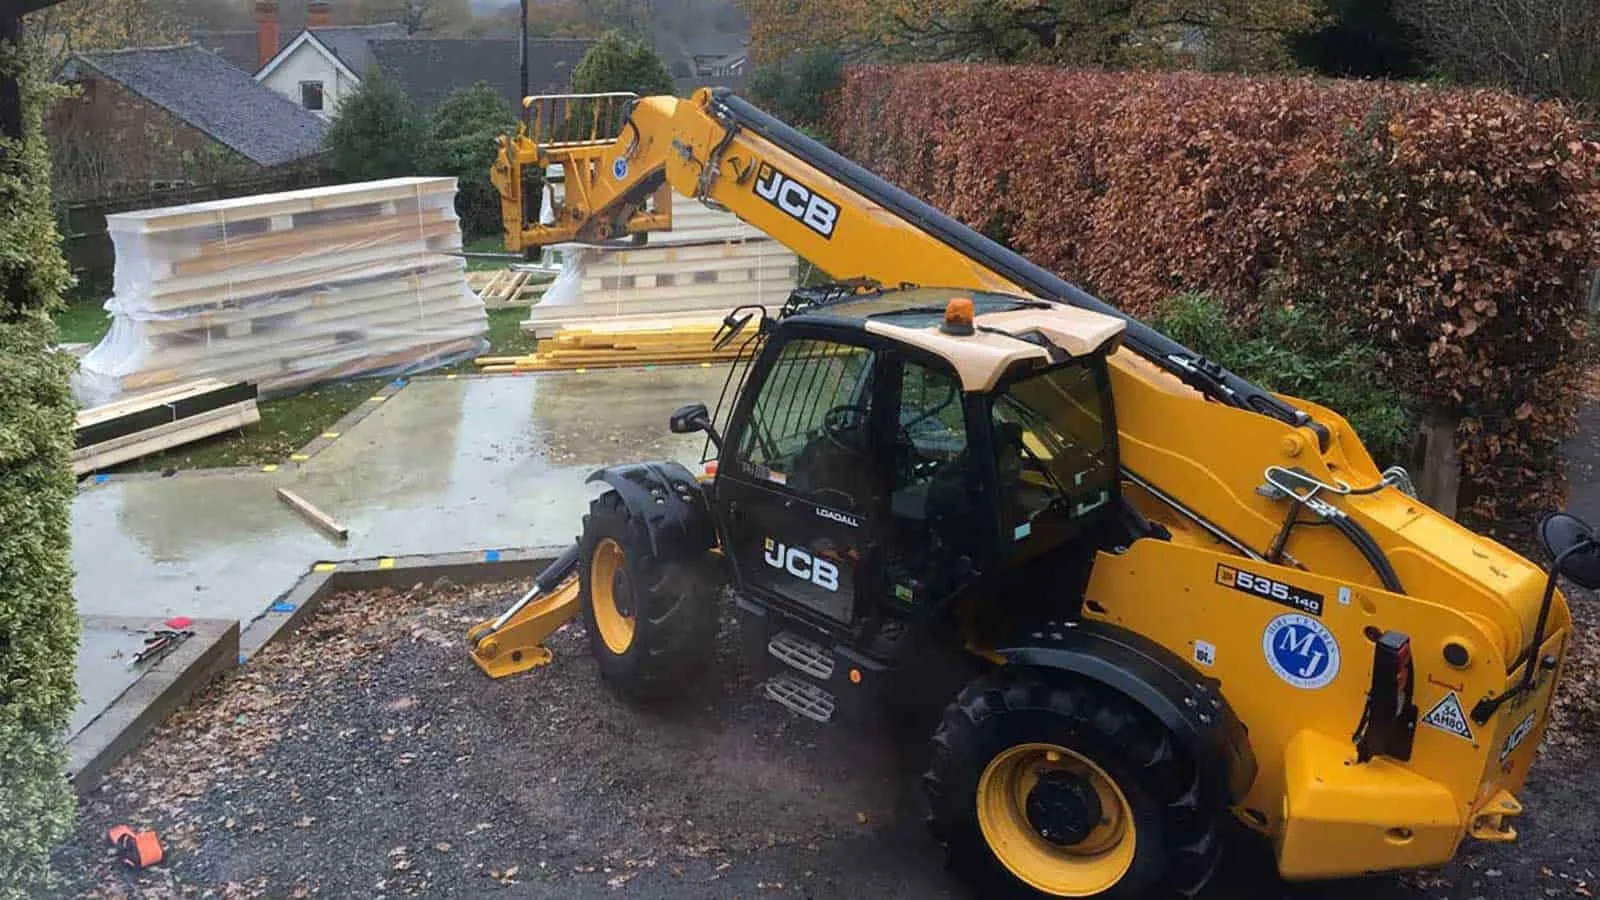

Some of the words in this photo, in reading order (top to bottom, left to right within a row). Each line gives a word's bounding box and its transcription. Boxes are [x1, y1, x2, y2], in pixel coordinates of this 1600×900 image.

[756, 173, 836, 234] JCB
[815, 507, 859, 527] LOADALL
[764, 543, 839, 591] JCB
